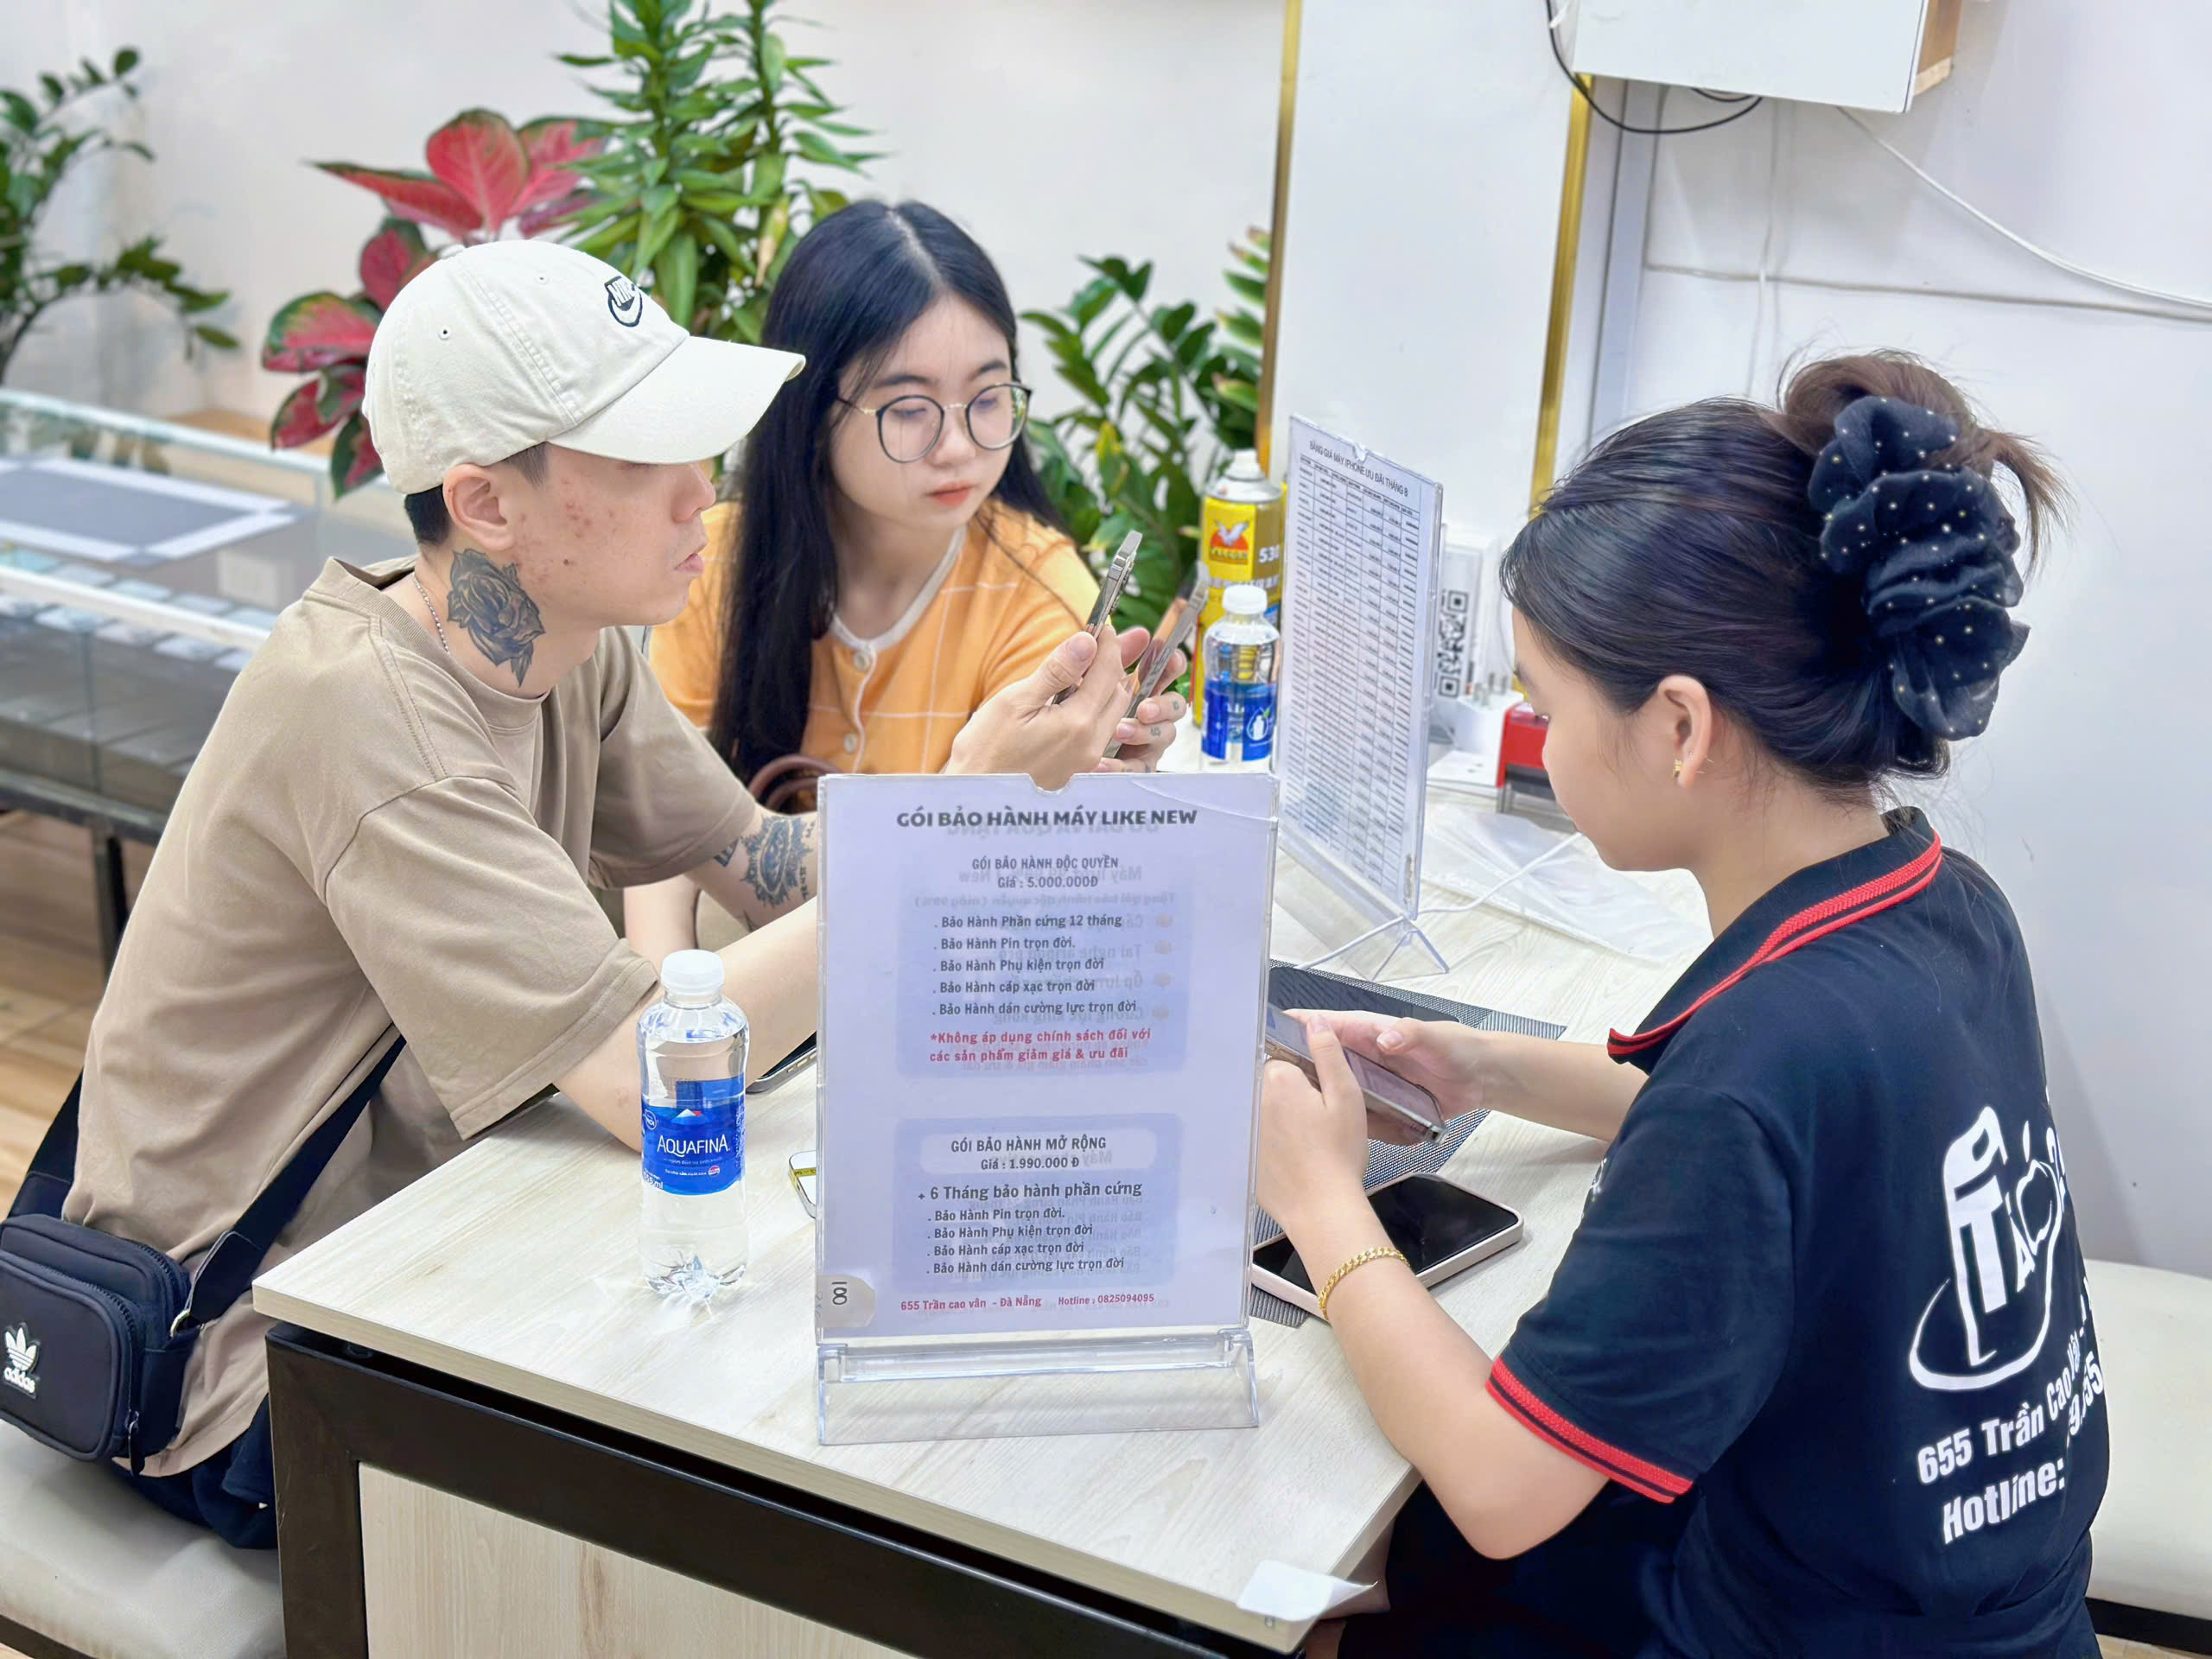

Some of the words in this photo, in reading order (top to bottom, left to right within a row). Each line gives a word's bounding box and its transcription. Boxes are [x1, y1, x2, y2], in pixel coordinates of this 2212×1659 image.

[1344, 457, 1365, 475] IPHONE
[1384, 476, 1405, 496] THÁNG
[896, 805, 933, 828] GÓI
[938, 805, 983, 827] BẢO
[986, 804, 1049, 826] HÀNH
[1052, 804, 1097, 826] MÁY
[1101, 810, 1147, 825] LIKE
[1150, 809, 1198, 824] NEW
[971, 855, 991, 870] GÓI
[995, 855, 1018, 870] BẢO
[1020, 854, 1052, 869] HÀNH
[1056, 854, 1078, 871] ĐỘC
[1081, 853, 1118, 869] QUYỀN
[997, 875, 1016, 889] Giá
[941, 915, 964, 928] Bảo
[967, 915, 998, 928] Hành
[1001, 914, 1032, 927] Phần
[1035, 914, 1066, 929] cứng
[1069, 914, 1084, 927] 12
[1087, 913, 1122, 928] tháng
[941, 937, 963, 950] Bảo
[966, 937, 997, 950] Hành
[1001, 937, 1020, 950] Pin
[1023, 937, 1049, 951] trọn
[1052, 935, 1076, 949] đời.
[940, 959, 963, 973] Bảo
[965, 958, 996, 972] Hành
[1000, 959, 1023, 974] Phụ
[1027, 957, 1052, 974] kiện
[1055, 959, 1081, 973] trọn
[1084, 957, 1105, 969] đời
[940, 981, 962, 994] Bảo
[965, 981, 995, 994] Hành
[999, 980, 1020, 995] cáp
[1023, 982, 1044, 995] xạc
[1046, 981, 1072, 995] trọn
[1075, 978, 1096, 992] đời
[939, 1002, 961, 1016] Bảo
[964, 1002, 995, 1015] Hành
[998, 1001, 1020, 1014] dán
[1024, 1001, 1063, 1016] cường
[1065, 1001, 1085, 1016] lực
[1088, 1002, 1115, 1014] trọn
[1117, 1000, 1137, 1013] đời
[982, 1032, 997, 1046] áp
[1001, 1032, 1033, 1046] dụng
[1036, 1030, 1071, 1043] chính
[1075, 1029, 1104, 1042] sách
[1108, 1027, 1128, 1040] đối
[1131, 1027, 1152, 1039] với
[929, 1049, 951, 1063] các
[954, 1048, 976, 1062] sản
[980, 1046, 1014, 1064] phẩm
[1017, 1047, 1048, 1063] giảm
[1052, 1047, 1071, 1062] giá
[1075, 1047, 1085, 1060] &
[1089, 1051, 1106, 1059] ưu
[1109, 1046, 1128, 1059] đãi
[657, 1134, 728, 1158] AQUAFINA
[950, 1136, 973, 1154] GÓI
[976, 1136, 1002, 1153] BẢO
[1005, 1135, 1042, 1152] HÀNH
[1045, 1135, 1068, 1151] MỞ
[1071, 1134, 1107, 1152] RỘNG
[980, 1159, 999, 1171] Giá
[1009, 1157, 1069, 1170] 1.990.000
[1071, 1156, 1080, 1168] Đ
[930, 1186, 939, 1200] 6
[944, 1185, 989, 1202] Tháng
[993, 1184, 1020, 1199] bảo
[1023, 1183, 1060, 1198] hành
[1064, 1180, 1101, 1199] phần
[1104, 1180, 1142, 1197] cứng
[934, 1210, 957, 1222] Bảo
[959, 1210, 989, 1221] Hành
[992, 1209, 1012, 1221] Pin
[1014, 1209, 1040, 1222] trọn
[1043, 1206, 1065, 1219] đời.
[934, 1228, 956, 1240] Bảo
[958, 1227, 988, 1239] Hành
[992, 1226, 1014, 1239] Phụ
[1017, 1224, 1043, 1238] kiện
[1046, 1225, 1071, 1238] trọn
[1074, 1224, 1093, 1236] đời
[933, 1245, 955, 1257] Bảo
[957, 1244, 988, 1256] Hành
[991, 1243, 1012, 1256] cáp
[1014, 1245, 1034, 1256] xạc
[1037, 1243, 1063, 1255] trọn
[1065, 1241, 1084, 1253] đời
[933, 1262, 955, 1274] Bảo
[957, 1262, 988, 1274] Hành
[990, 1261, 1012, 1272] dán
[1014, 1259, 1053, 1272] cường
[1056, 1259, 1075, 1273] lực
[1077, 1259, 1103, 1272] trọn
[1105, 1257, 1125, 1268] đời
[900, 1300, 920, 1311] 655
[922, 1299, 946, 1311] Trần
[948, 1300, 966, 1309] cao
[969, 1298, 987, 1309] vân
[1000, 1297, 1013, 1307] Đà
[1015, 1294, 1042, 1307] Nẵng
[1058, 1296, 1090, 1306] Hotline
[1097, 1294, 1154, 1304] 0825094095
[3, 1366, 36, 1394] adidas
[1917, 1427, 1973, 1485] 655
[1981, 1401, 2044, 1458] Trần
[2046, 1366, 2072, 1421] Cao
[1942, 1457, 2065, 1545] Hotline:
